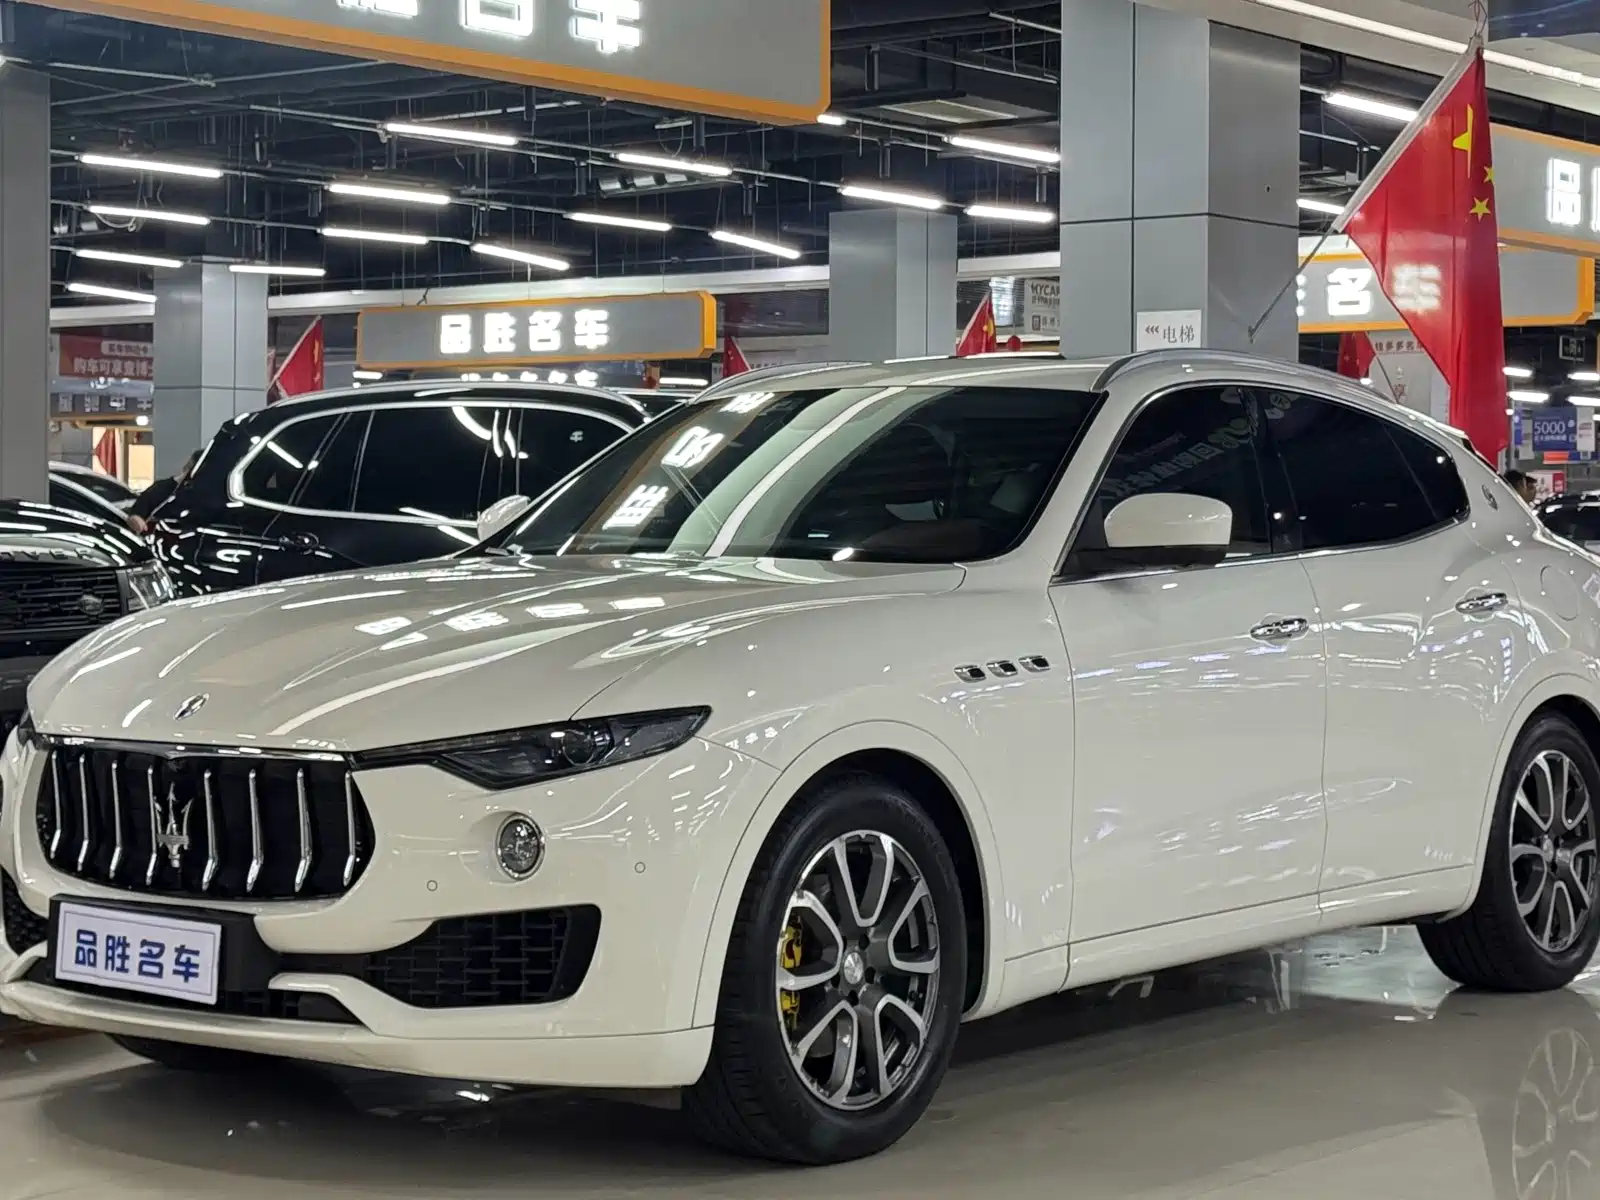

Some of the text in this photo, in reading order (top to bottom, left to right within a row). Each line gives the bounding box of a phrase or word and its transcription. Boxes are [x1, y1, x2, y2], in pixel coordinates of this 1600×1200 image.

[1296, 264, 1442, 316] 名车
[440, 308, 609, 354] 品胜名车
[1163, 324, 1195, 343] 电梯
[1534, 421, 1566, 434] 5000
[75, 928, 200, 983] 品胜名车
